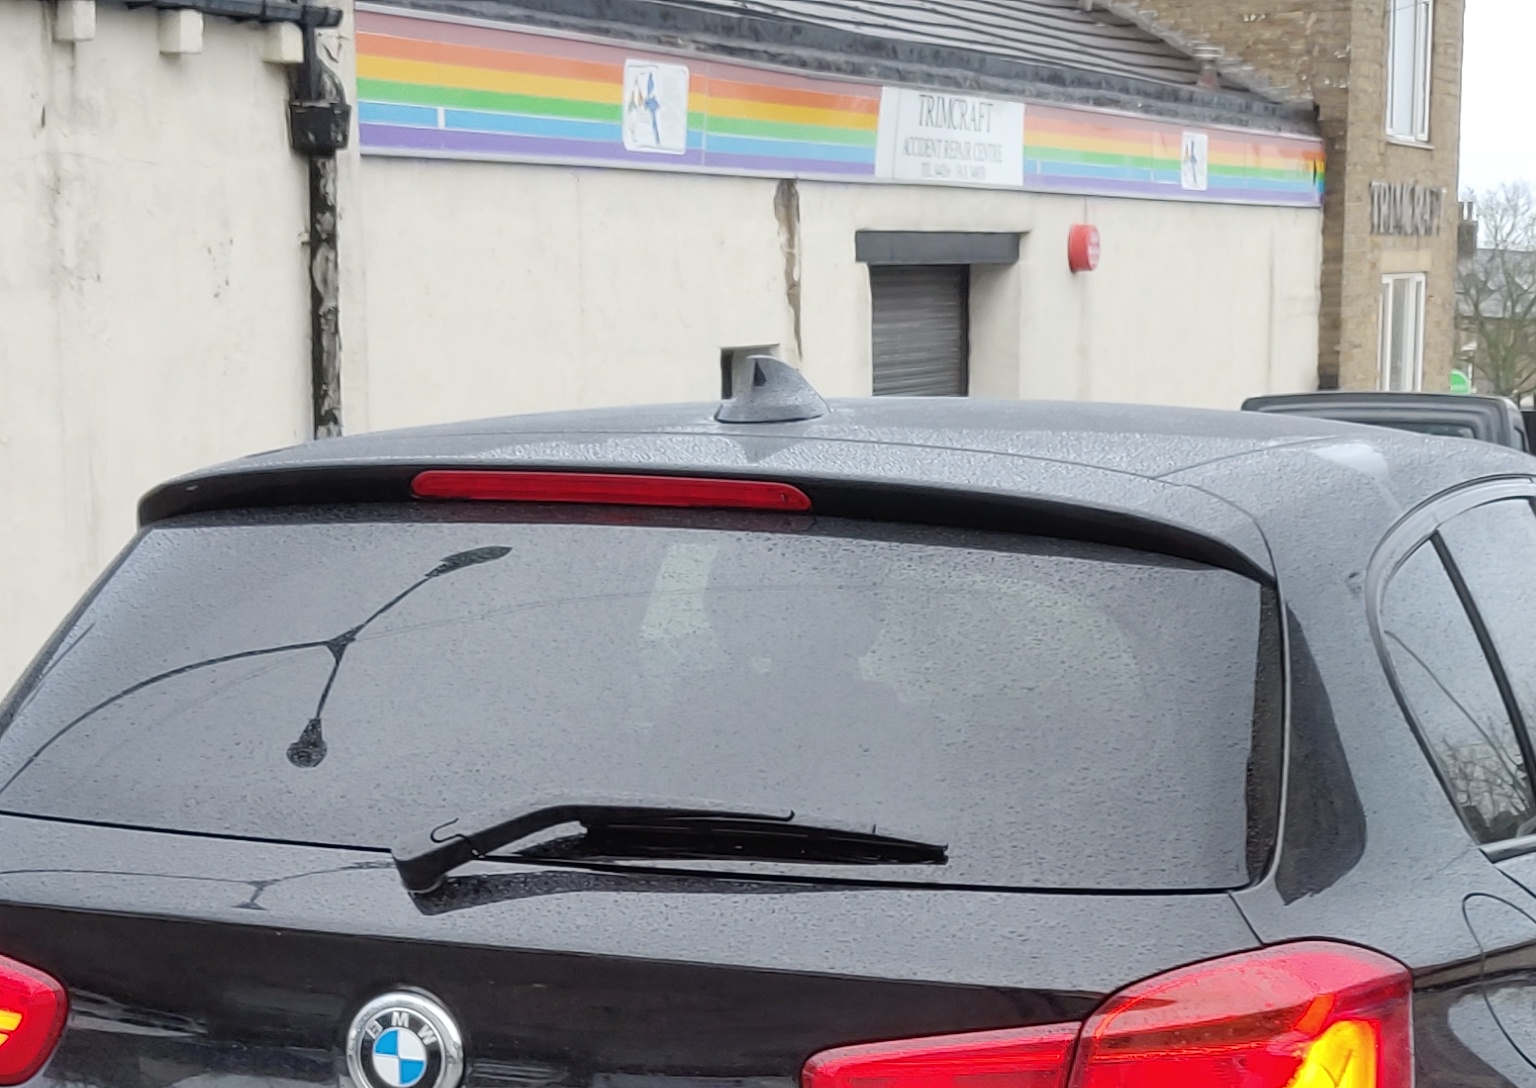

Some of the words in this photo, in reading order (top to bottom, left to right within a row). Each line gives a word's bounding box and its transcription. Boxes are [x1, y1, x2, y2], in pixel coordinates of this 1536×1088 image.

[919, 94, 994, 133] TRIMCRAFT
[903, 137, 942, 158] ACCIDENT
[365, 1011, 438, 1046] BMW
